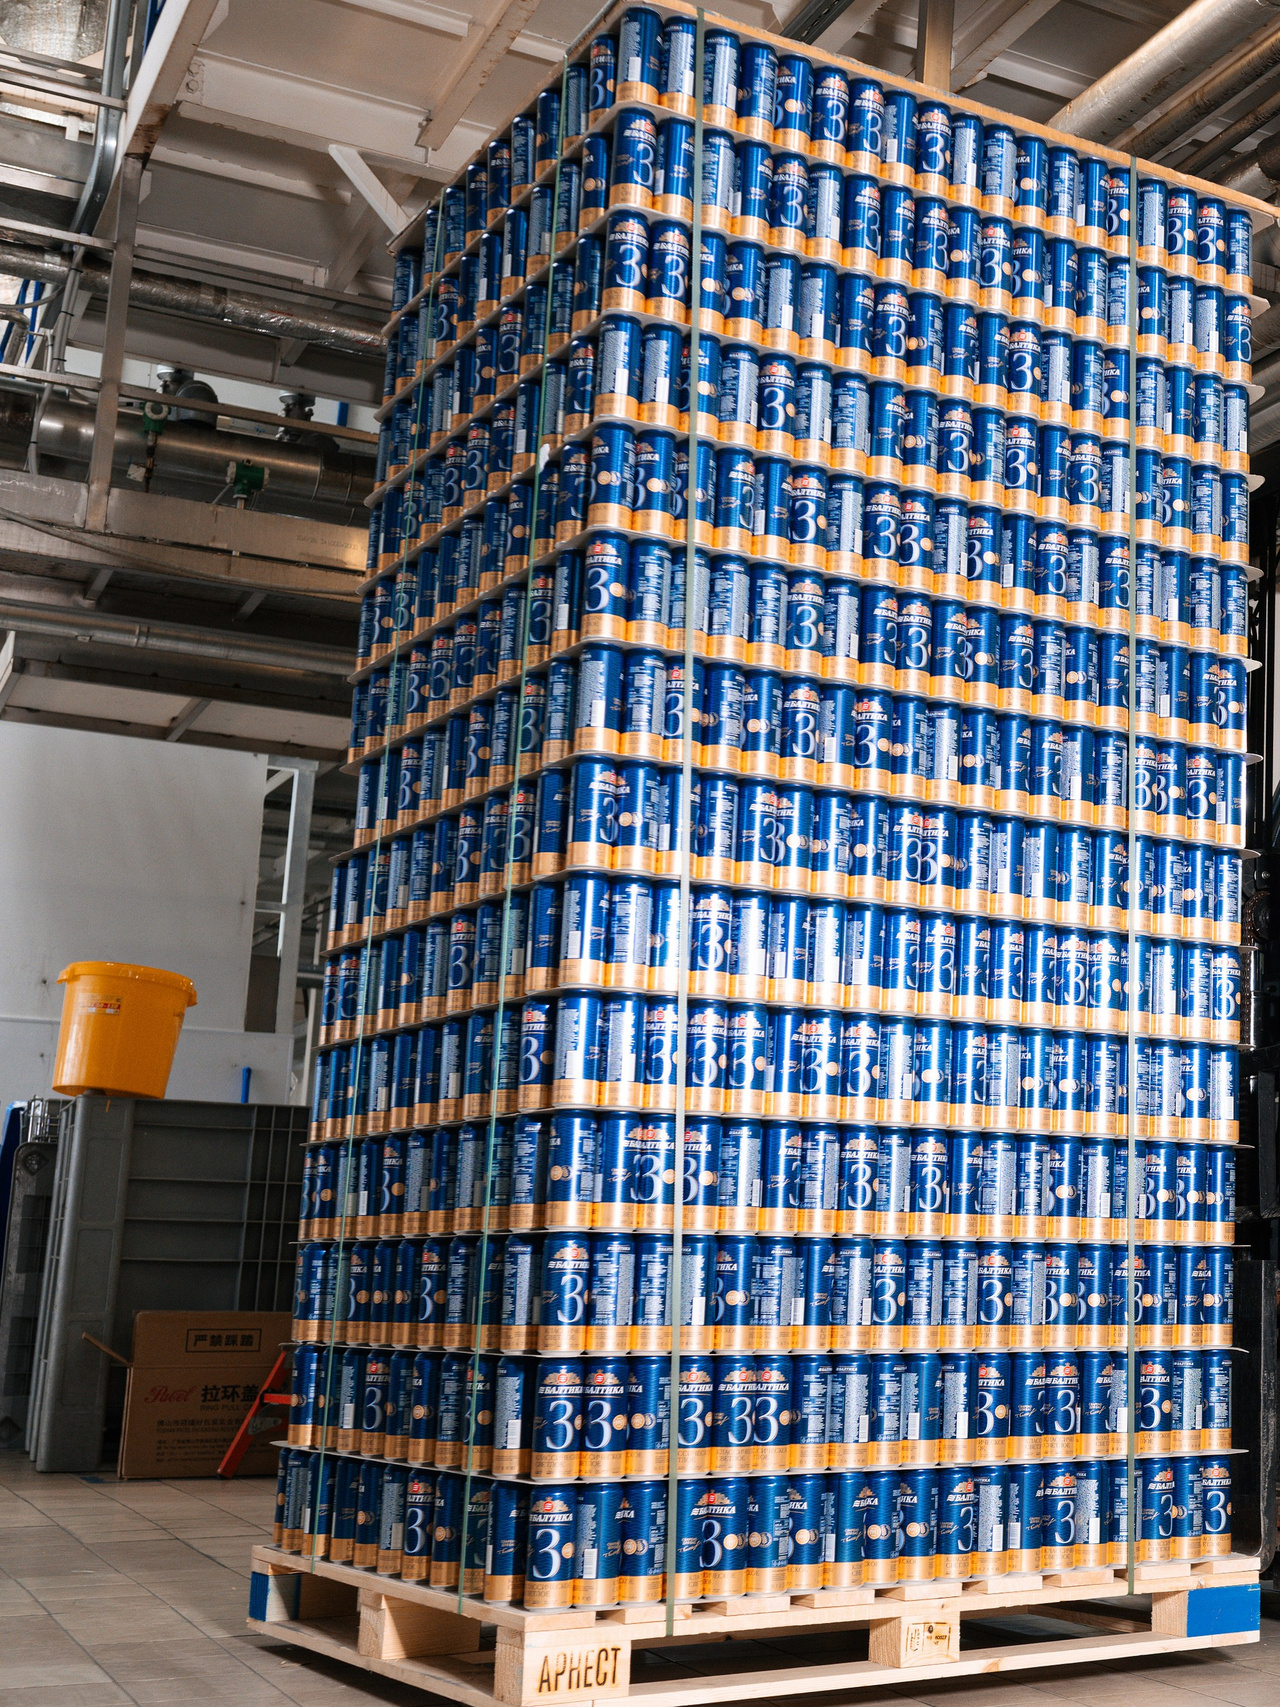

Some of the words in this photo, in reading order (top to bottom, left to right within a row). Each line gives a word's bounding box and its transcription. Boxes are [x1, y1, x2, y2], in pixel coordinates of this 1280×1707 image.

[824, 101, 845, 141] 3
[863, 117, 882, 153] 3
[633, 143, 654, 186] 3
[923, 134, 944, 171] 3
[780, 187, 804, 226] 3
[1198, 227, 1216, 262] 3
[616, 246, 640, 287] 3
[661, 255, 684, 297] 3
[981, 250, 1001, 285] 3
[887, 316, 906, 356] 3
[1011, 353, 1032, 389] 3
[763, 388, 787, 428] 3
[948, 433, 968, 473] 3
[1005, 449, 1027, 487] 3
[1079, 466, 1099, 503] 3
[792, 501, 816, 541] 3
[874, 517, 896, 556] 3
[900, 524, 919, 563] 3
[585, 568, 609, 611] 3
[530, 602, 550, 642] 3
[795, 606, 818, 647] 3
[906, 627, 928, 668] 3
[793, 713, 815, 755] 3
[855, 725, 877, 765] 3
[1187, 780, 1208, 817] 3
[903, 838, 922, 880] 3
[698, 924, 724, 968] 3
[1064, 964, 1085, 1004] 3
[1090, 967, 1111, 1005] 3
[1215, 980, 1235, 1018] 3
[646, 1023, 678, 1032] БАЛТИ
[691, 1025, 727, 1036] БАЛТИК
[805, 1035, 836, 1043] АЛТИКА
[646, 1037, 671, 1081] 3
[692, 1040, 717, 1085] 3
[729, 1042, 754, 1086] 3
[803, 1048, 824, 1091] 3
[847, 1049, 871, 1093] 3
[639, 1142, 675, 1150] АЛТИКА
[848, 1151, 879, 1160] БАЛТИК
[917, 1154, 947, 1163] БАЛТИК
[640, 1155, 662, 1201] 3
[848, 1164, 872, 1207] 3
[919, 1166, 942, 1210] 3
[874, 1266, 905, 1274] АЛТИКА
[558, 1275, 583, 1322] 3
[874, 1279, 896, 1322] 3
[980, 1279, 1003, 1322] 3
[194, 1334, 254, 1347] 严禁踩踏
[754, 1383, 789, 1391] АЛТИКА
[1052, 1376, 1079, 1385] БАЛТИК
[1140, 1375, 1169, 1383] АЛТИКА
[546, 1400, 573, 1449] 3
[585, 1400, 612, 1449] 3
[678, 1398, 703, 1445] 3
[729, 1397, 752, 1443] 3
[754, 1397, 777, 1443] 3
[1055, 1391, 1075, 1433] 3
[1141, 1388, 1160, 1428] 3
[1206, 1491, 1226, 1531] 3
[533, 1529, 560, 1579] 3
[700, 1520, 721, 1568] 3
